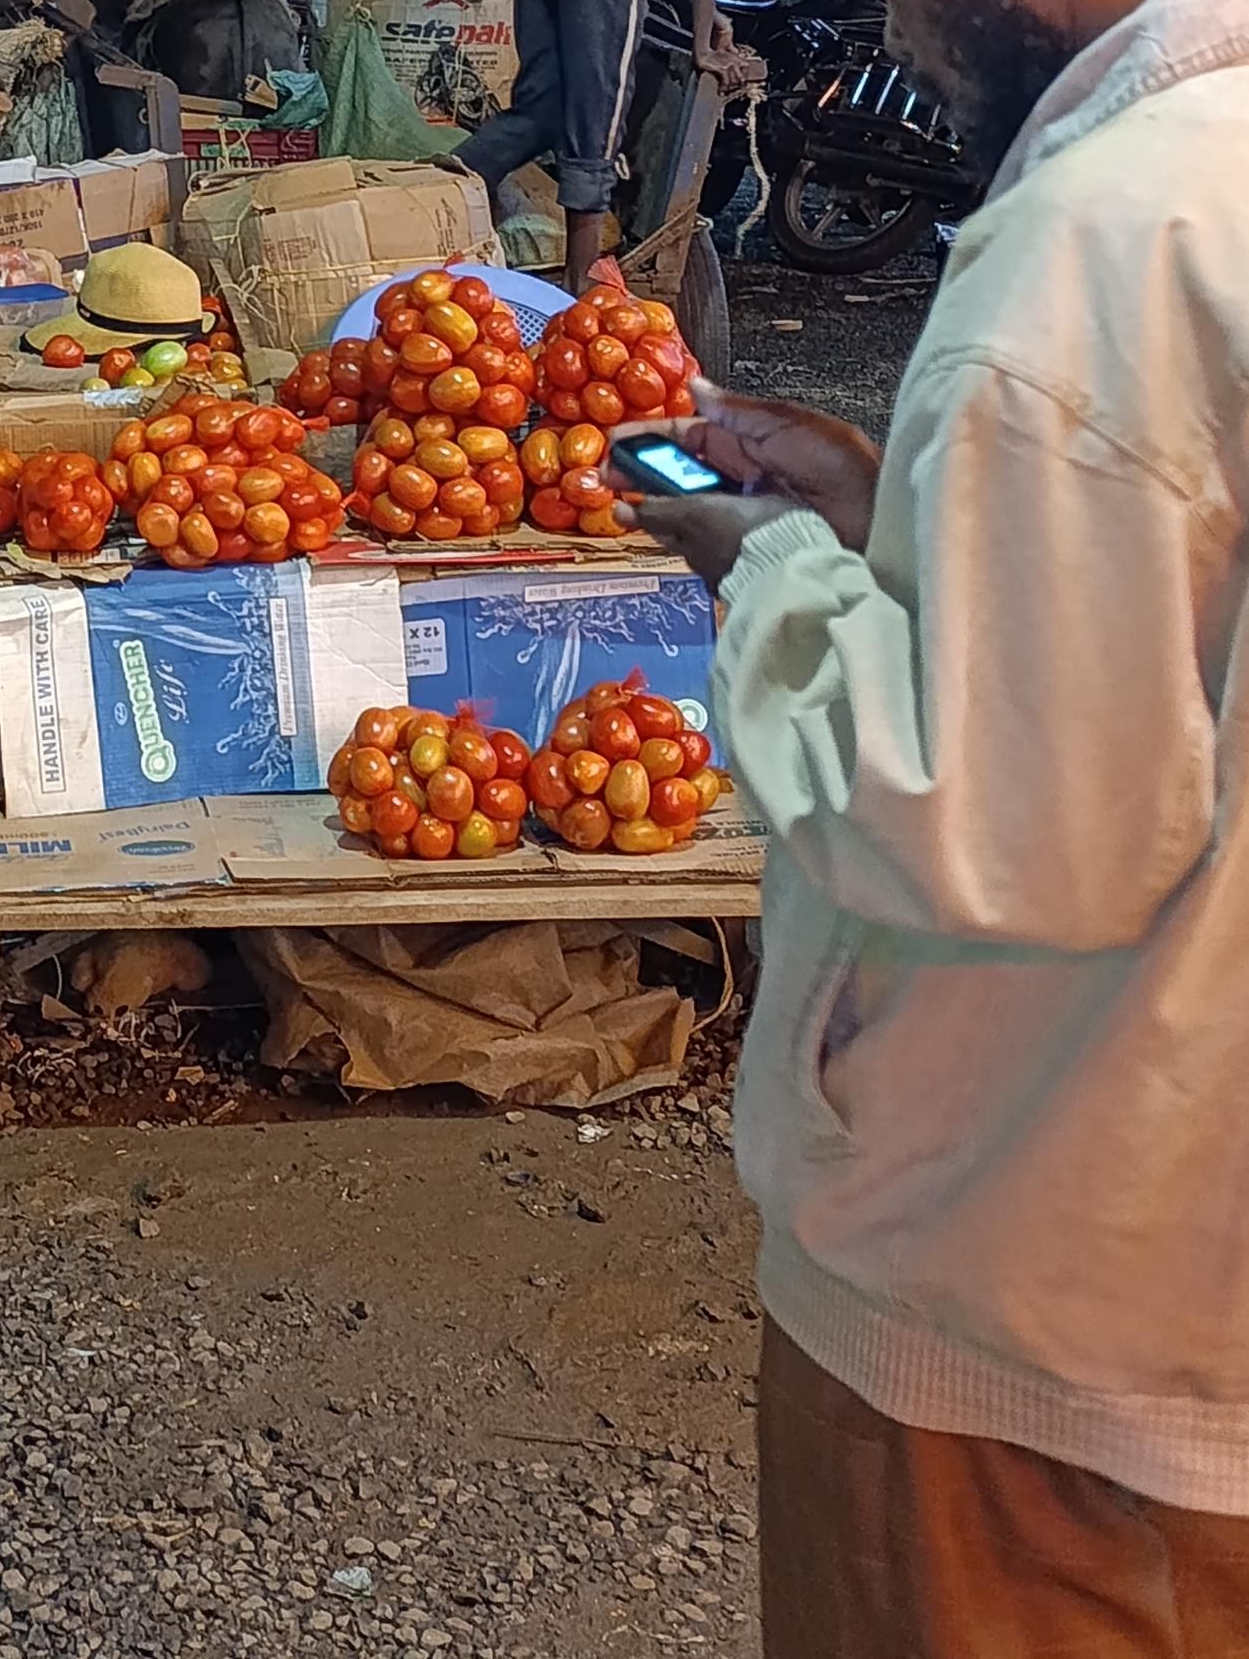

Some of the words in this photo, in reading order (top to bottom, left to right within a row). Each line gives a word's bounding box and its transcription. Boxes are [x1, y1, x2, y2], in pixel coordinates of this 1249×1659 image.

[32, 597, 50, 646] CARE
[409, 628, 420, 640] X
[422, 626, 440, 638] 12
[36, 648, 54, 700] WITH
[155, 657, 190, 725] Life
[123, 640, 173, 780] QUENCHER
[39, 702, 61, 784] HANDLE
